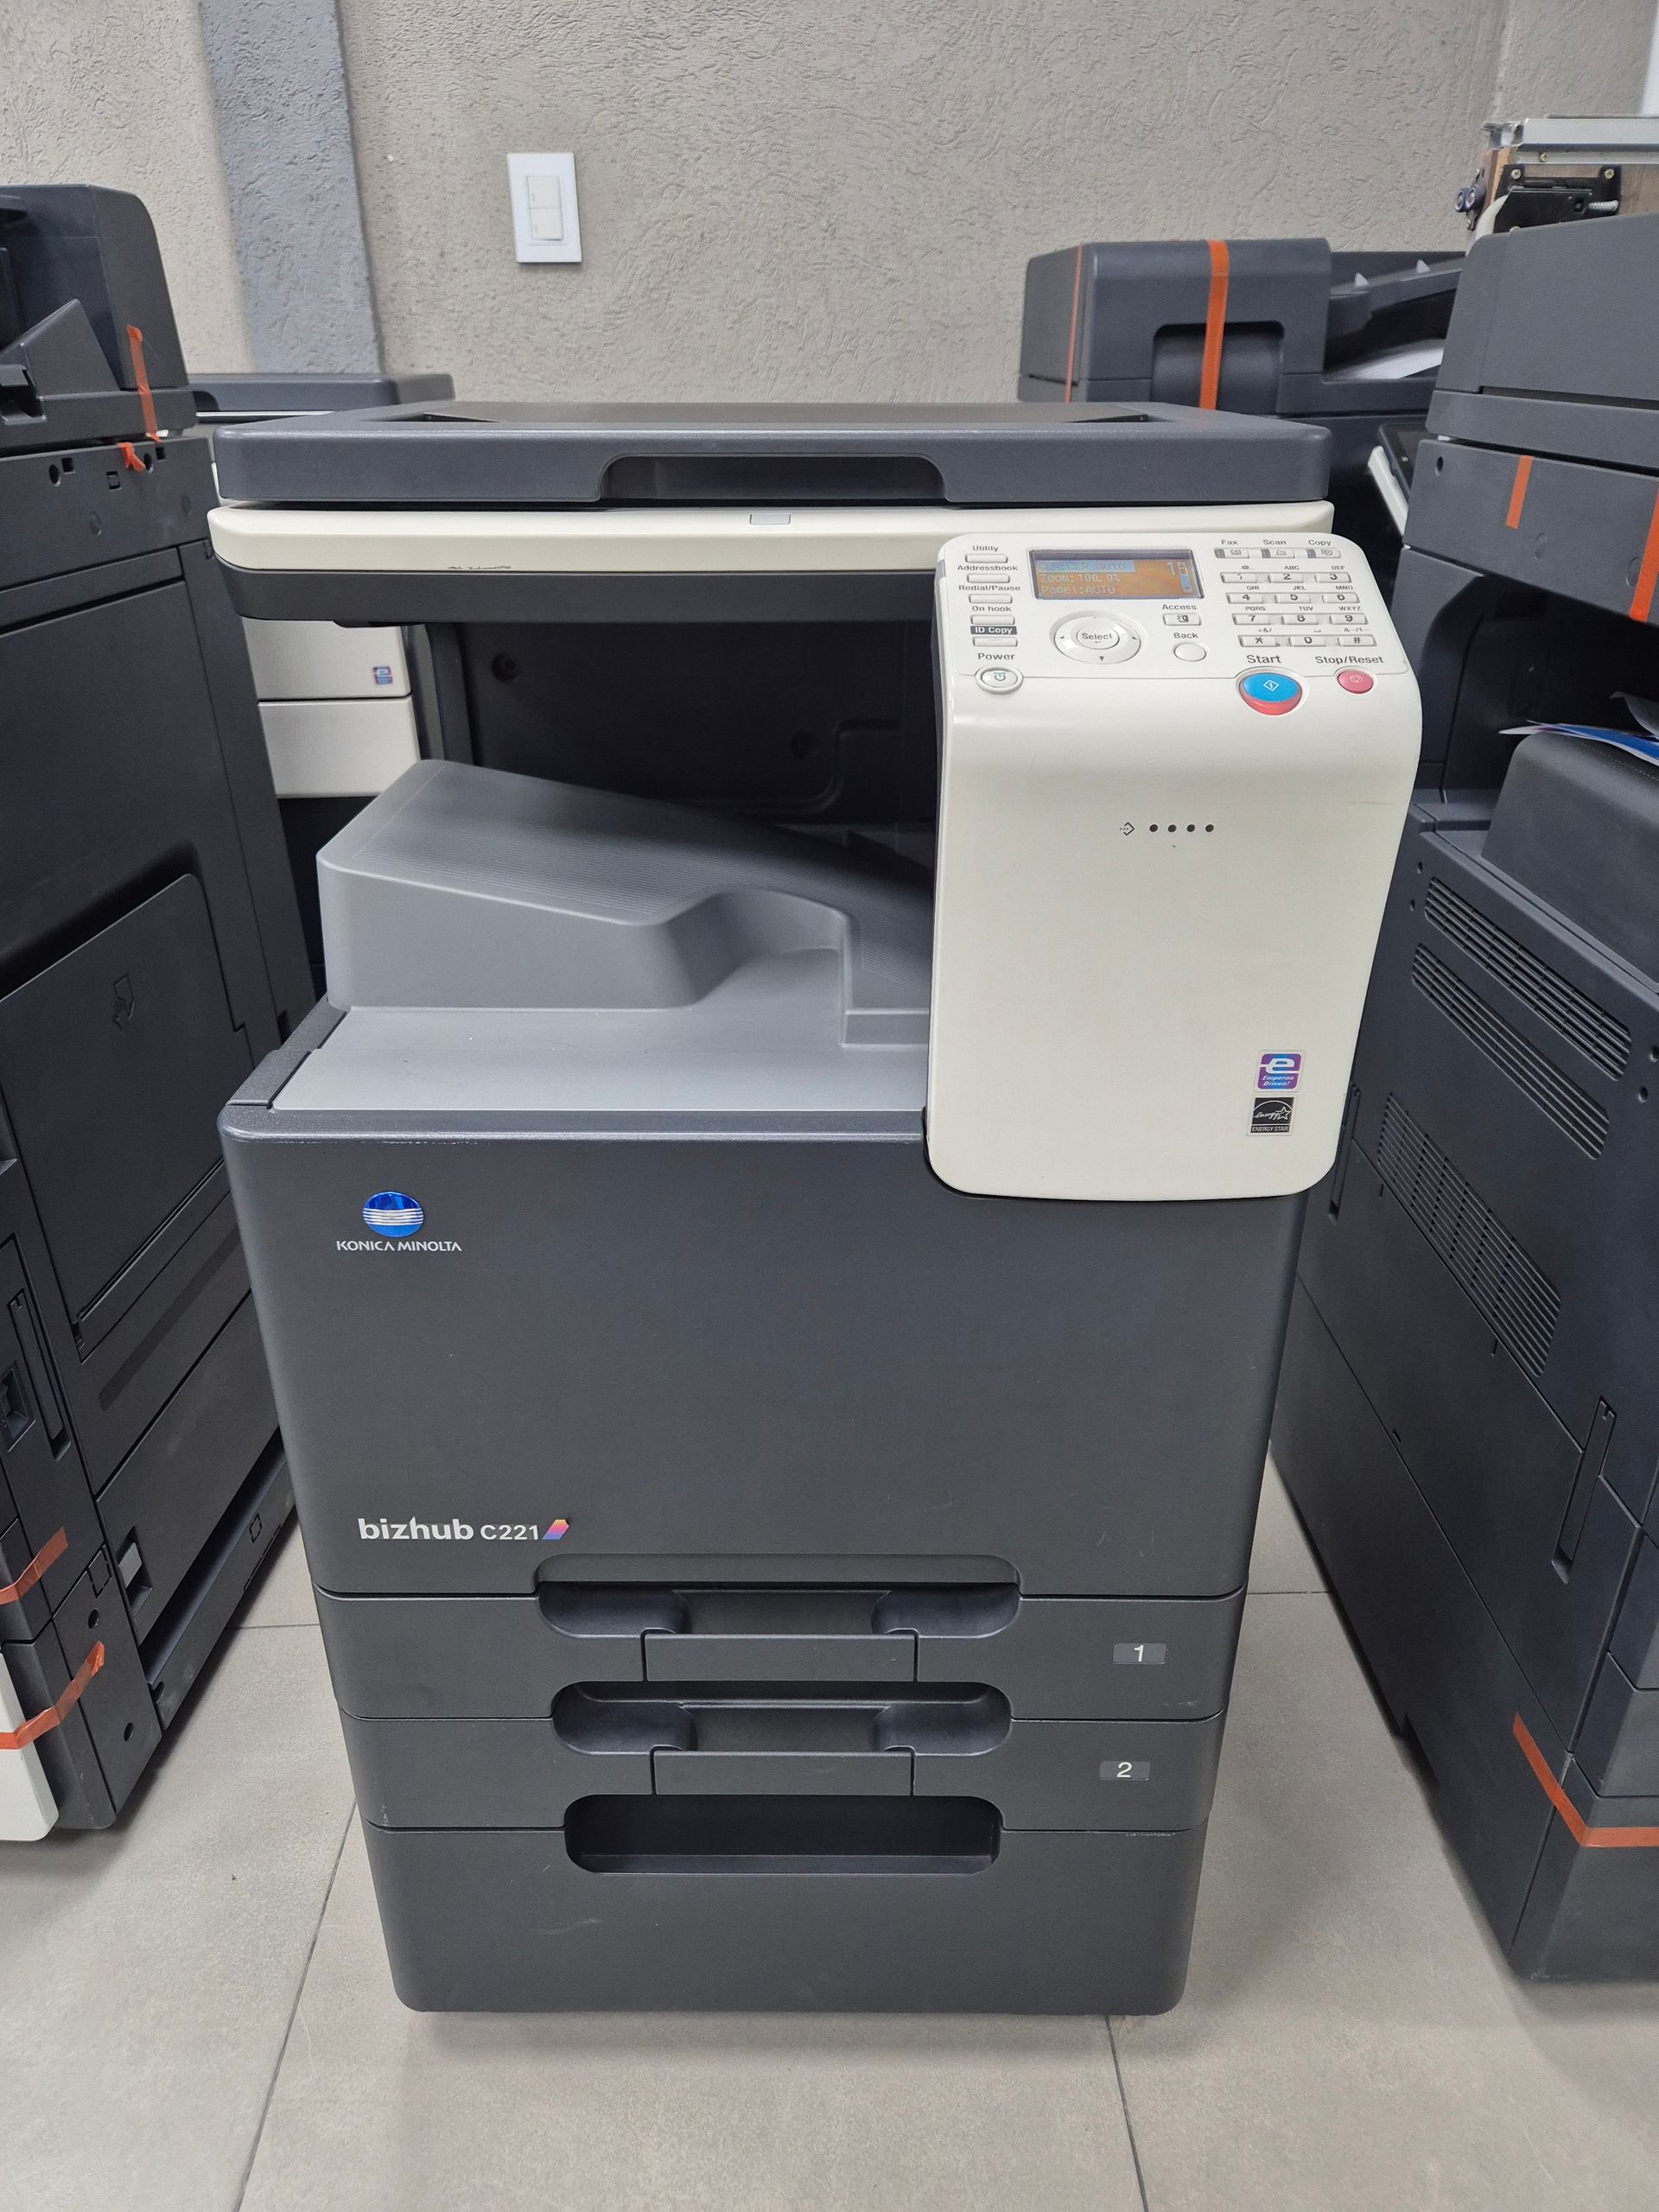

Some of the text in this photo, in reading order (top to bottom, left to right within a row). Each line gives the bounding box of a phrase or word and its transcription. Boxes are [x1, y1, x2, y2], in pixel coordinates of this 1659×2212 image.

[988, 626, 1013, 635] Copy
[1246, 654, 1282, 664] Start
[1314, 656, 1384, 665] Stop/Reset
[336, 1240, 462, 1252] KONICA MINOLTA
[358, 1516, 539, 1541] bizhub C221
[1134, 1644, 1144, 1662] 1
[1116, 1761, 1133, 1778] 2
